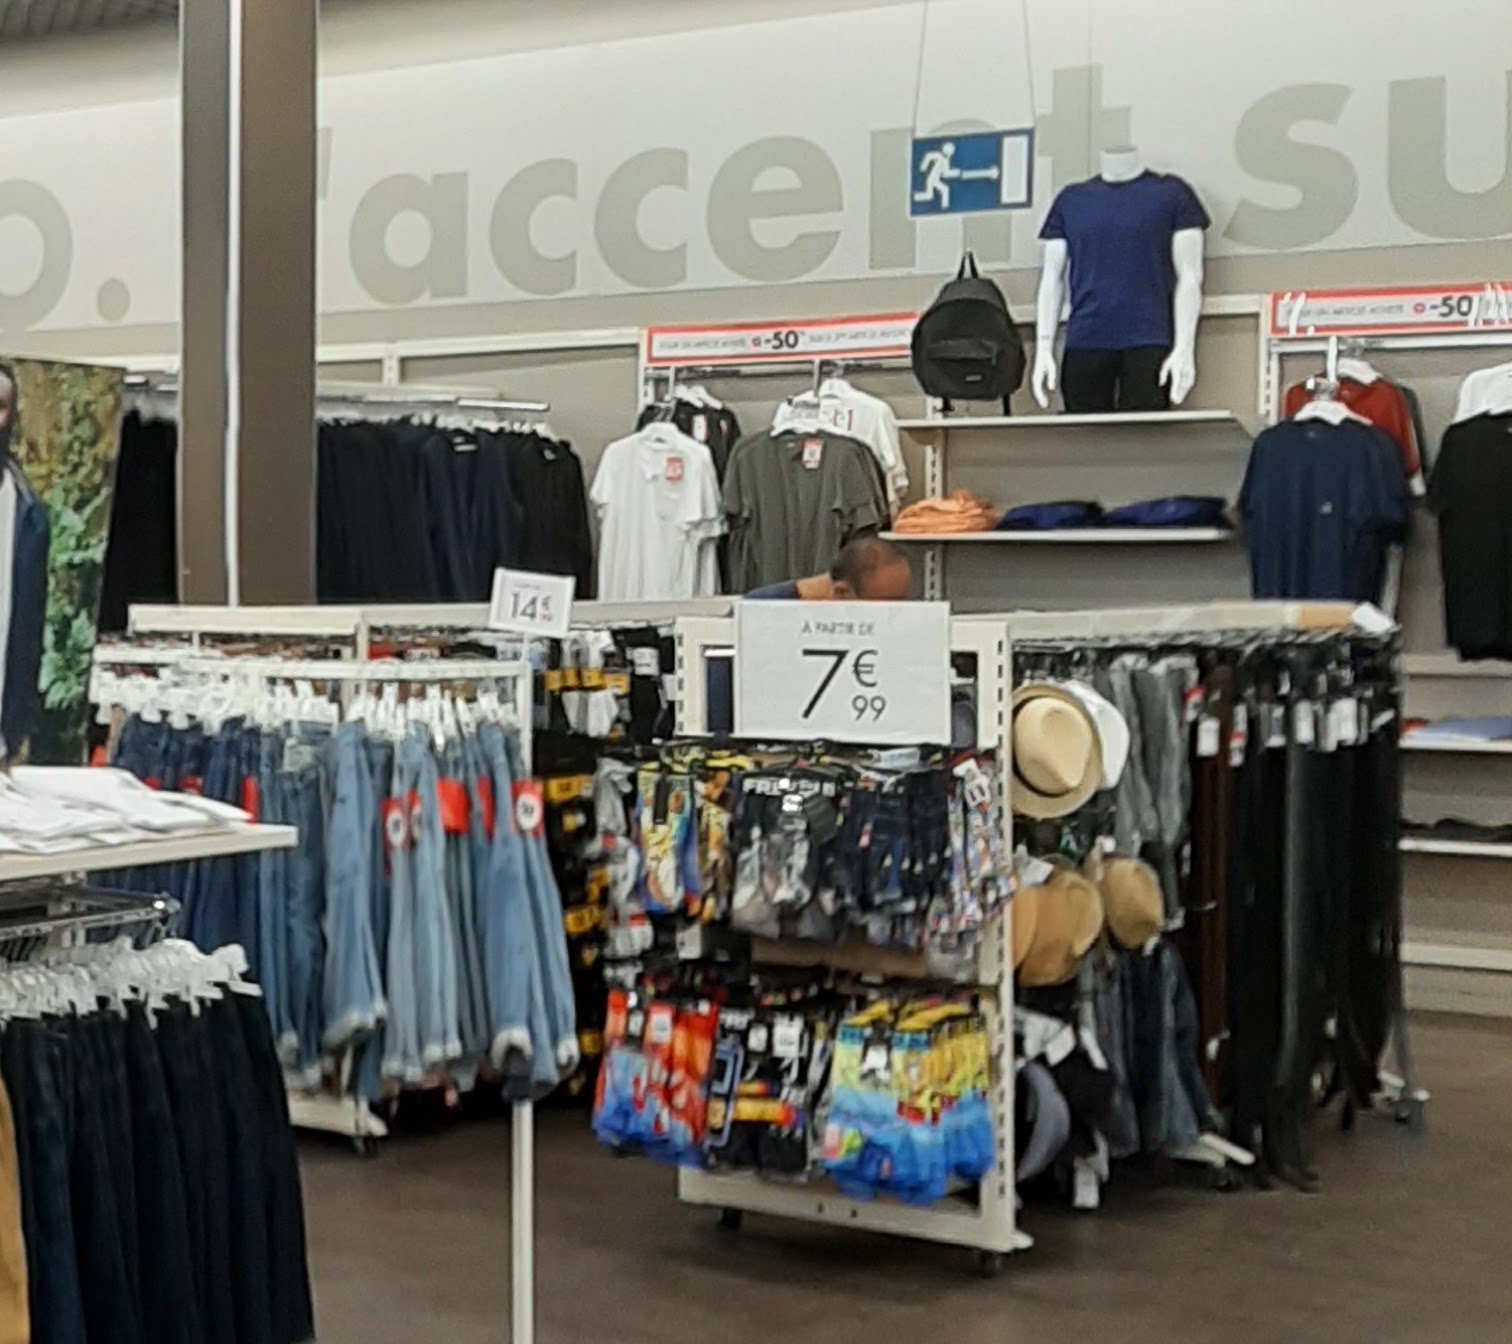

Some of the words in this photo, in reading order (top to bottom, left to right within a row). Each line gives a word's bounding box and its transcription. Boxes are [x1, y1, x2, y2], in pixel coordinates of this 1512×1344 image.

[802, 648, 849, 719] 7
[852, 649, 879, 688] €
[851, 695, 886, 722] 99
